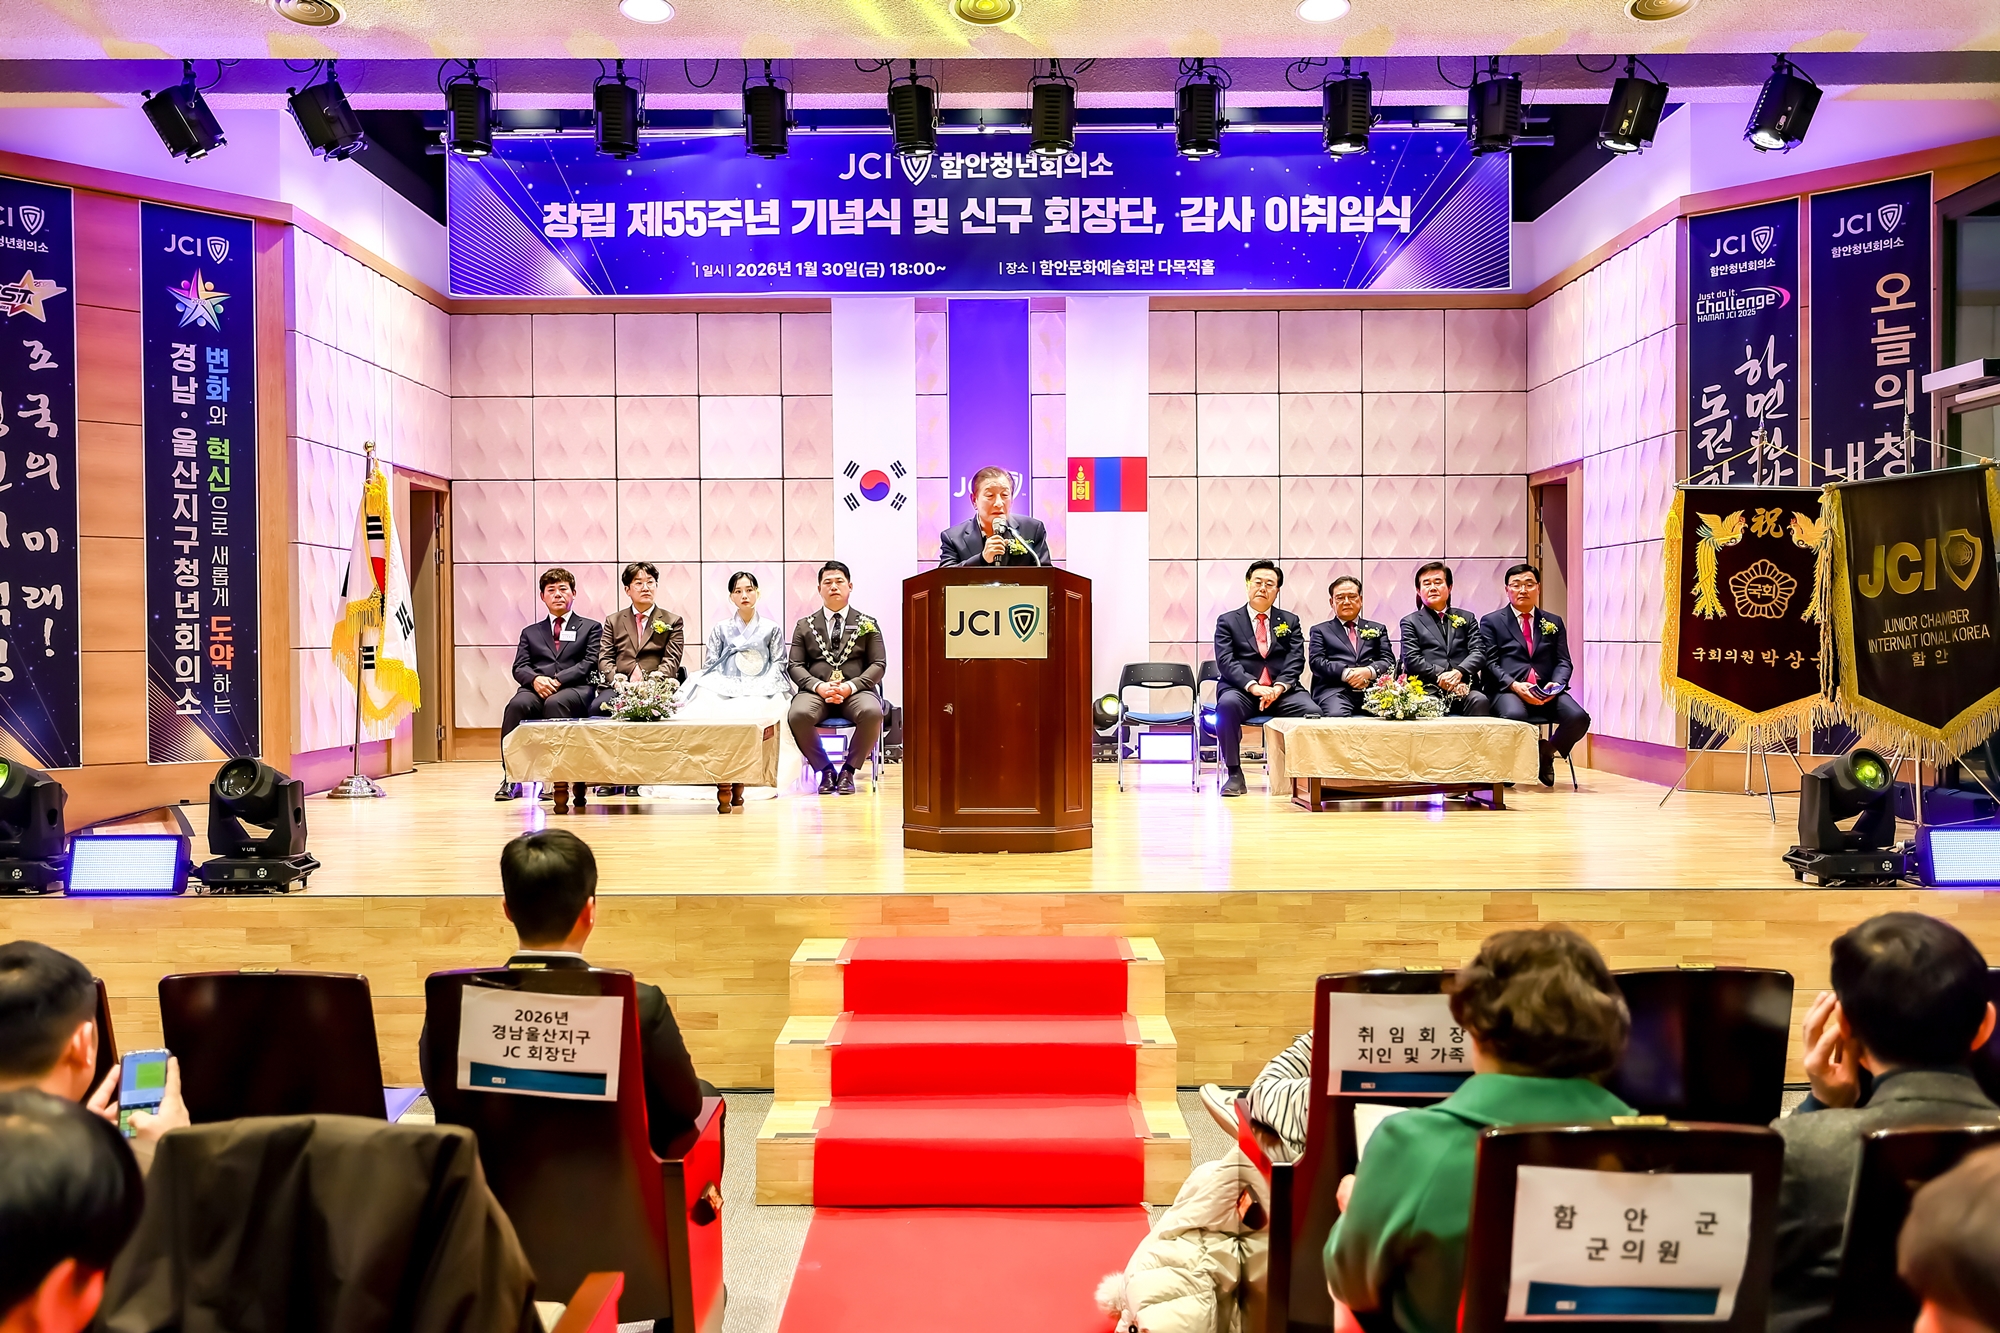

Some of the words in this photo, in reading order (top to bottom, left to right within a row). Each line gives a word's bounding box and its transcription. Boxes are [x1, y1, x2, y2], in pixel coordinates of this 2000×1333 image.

[838, 153, 892, 180] JCI
[939, 151, 1114, 179] 함안청년회의소
[542, 201, 616, 238] 창립
[627, 197, 780, 238] 제55주년
[791, 197, 900, 235] 기념식
[913, 198, 948, 233] 및
[959, 196, 1034, 234] 신구
[1044, 195, 1165, 235] 회장단,
[1180, 196, 1255, 233] 감사
[1264, 195, 1412, 233] 이취임식
[1831, 211, 1872, 238] JCI
[163, 233, 202, 257] JCI
[1709, 233, 1746, 258] JCI
[1830, 236, 1905, 259] 함안청년회의소
[735, 261, 792, 277] 2026년
[795, 261, 818, 277] 1월
[821, 261, 885, 279] 30일(금)
[889, 262, 947, 276] 18:00~
[1039, 259, 1155, 276] 함안문화예술회관
[1158, 259, 1216, 276] 다목적홀
[1709, 257, 1776, 278] 함안청년회의소
[0, 286, 34, 305] ST
[1696, 293, 1776, 315] Challenge
[1697, 291, 1715, 301] Just
[1716, 290, 1727, 298] do
[1697, 312, 1725, 323] HAMAN
[1726, 310, 1737, 319] JCI
[1737, 308, 1757, 318] 2025
[1870, 272, 1917, 416] 오늘의
[205, 346, 231, 426] 변화와
[18, 339, 60, 490] 조국의
[206, 436, 231, 536] 혁신으로
[1750, 507, 1784, 538] 祝
[211, 545, 229, 607] 새롭게
[1857, 538, 1938, 599] JCI
[22, 527, 63, 657] 미래!
[1747, 583, 1776, 599] 국회
[948, 610, 1000, 636] JCI
[1882, 615, 1919, 634] JUNIOR
[1920, 608, 1970, 629] CHAMBER
[1952, 624, 1991, 643] KOREA
[209, 615, 234, 714] 도약하는
[1692, 647, 1754, 665] 국회의원
[514, 1009, 569, 1026] 2026년
[491, 1024, 591, 1045] 경남울산지구
[502, 1046, 521, 1058] JC
[527, 1045, 577, 1062] 회장단
[1358, 1047, 1391, 1064] 지인
[1404, 1047, 1419, 1064] 및
[1430, 1047, 1465, 1063] 가족
